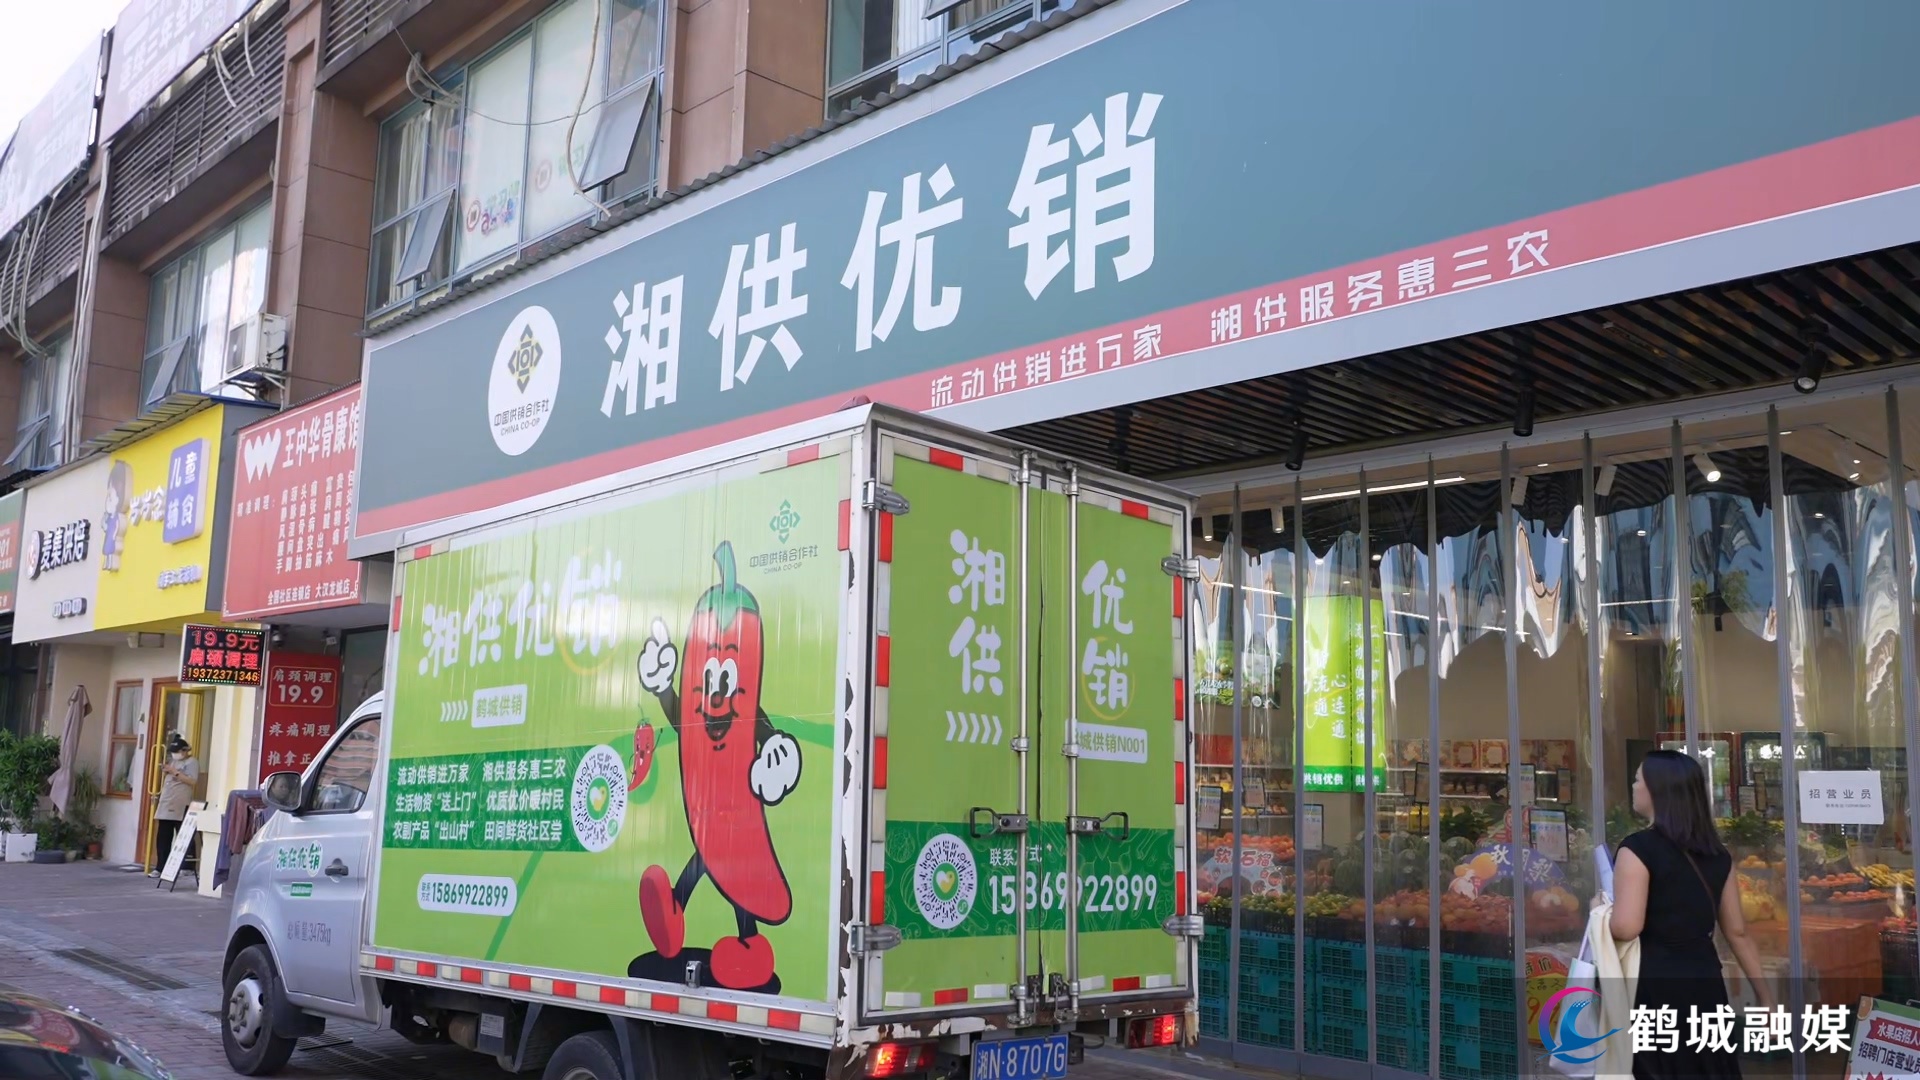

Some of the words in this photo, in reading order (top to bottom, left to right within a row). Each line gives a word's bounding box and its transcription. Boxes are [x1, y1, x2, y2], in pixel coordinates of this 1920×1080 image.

[600, 92, 1164, 419] 湘供优销
[931, 323, 1163, 408] 流动供销进万家
[1211, 229, 1551, 343] 湘供服务惠三农
[494, 398, 550, 427] 中国供销合作社
[282, 400, 360, 468] 王中华骨康馆
[500, 423, 519, 436] CHINA
[520, 417, 540, 431] CO-OP
[170, 451, 198, 490] 儿童
[749, 545, 818, 568] 中国供销合作社
[763, 564, 781, 575] CHINA
[315, 578, 350, 599] 大汉龙城店
[418, 550, 622, 678] 湘供优销
[948, 529, 1005, 696] 湘供
[191, 630, 260, 651] 19.9元
[1081, 560, 1134, 710] 优销
[188, 648, 259, 669] 肩颈调理
[188, 667, 258, 682] 19372371346
[273, 668, 333, 684] 肩颈调理
[278, 685, 324, 704] 19.9
[475, 694, 524, 719] 鹤城供销
[269, 721, 331, 738] 疼痛调理
[1075, 730, 1146, 755] 城供销N001
[397, 763, 470, 786] 流动供销进万家
[482, 758, 567, 783] 湘供服务惠三农
[486, 788, 564, 812] 优质优价暖村民
[1809, 788, 1872, 800] 招营业员
[484, 820, 563, 842] 田间鲜货社区尝
[989, 845, 1043, 867] 联系式
[1214, 845, 1274, 868] 软石榴
[432, 881, 509, 908] 15869922899
[989, 871, 1158, 915] 1586922899
[1877, 1022, 1920, 1047] 水果店招人
